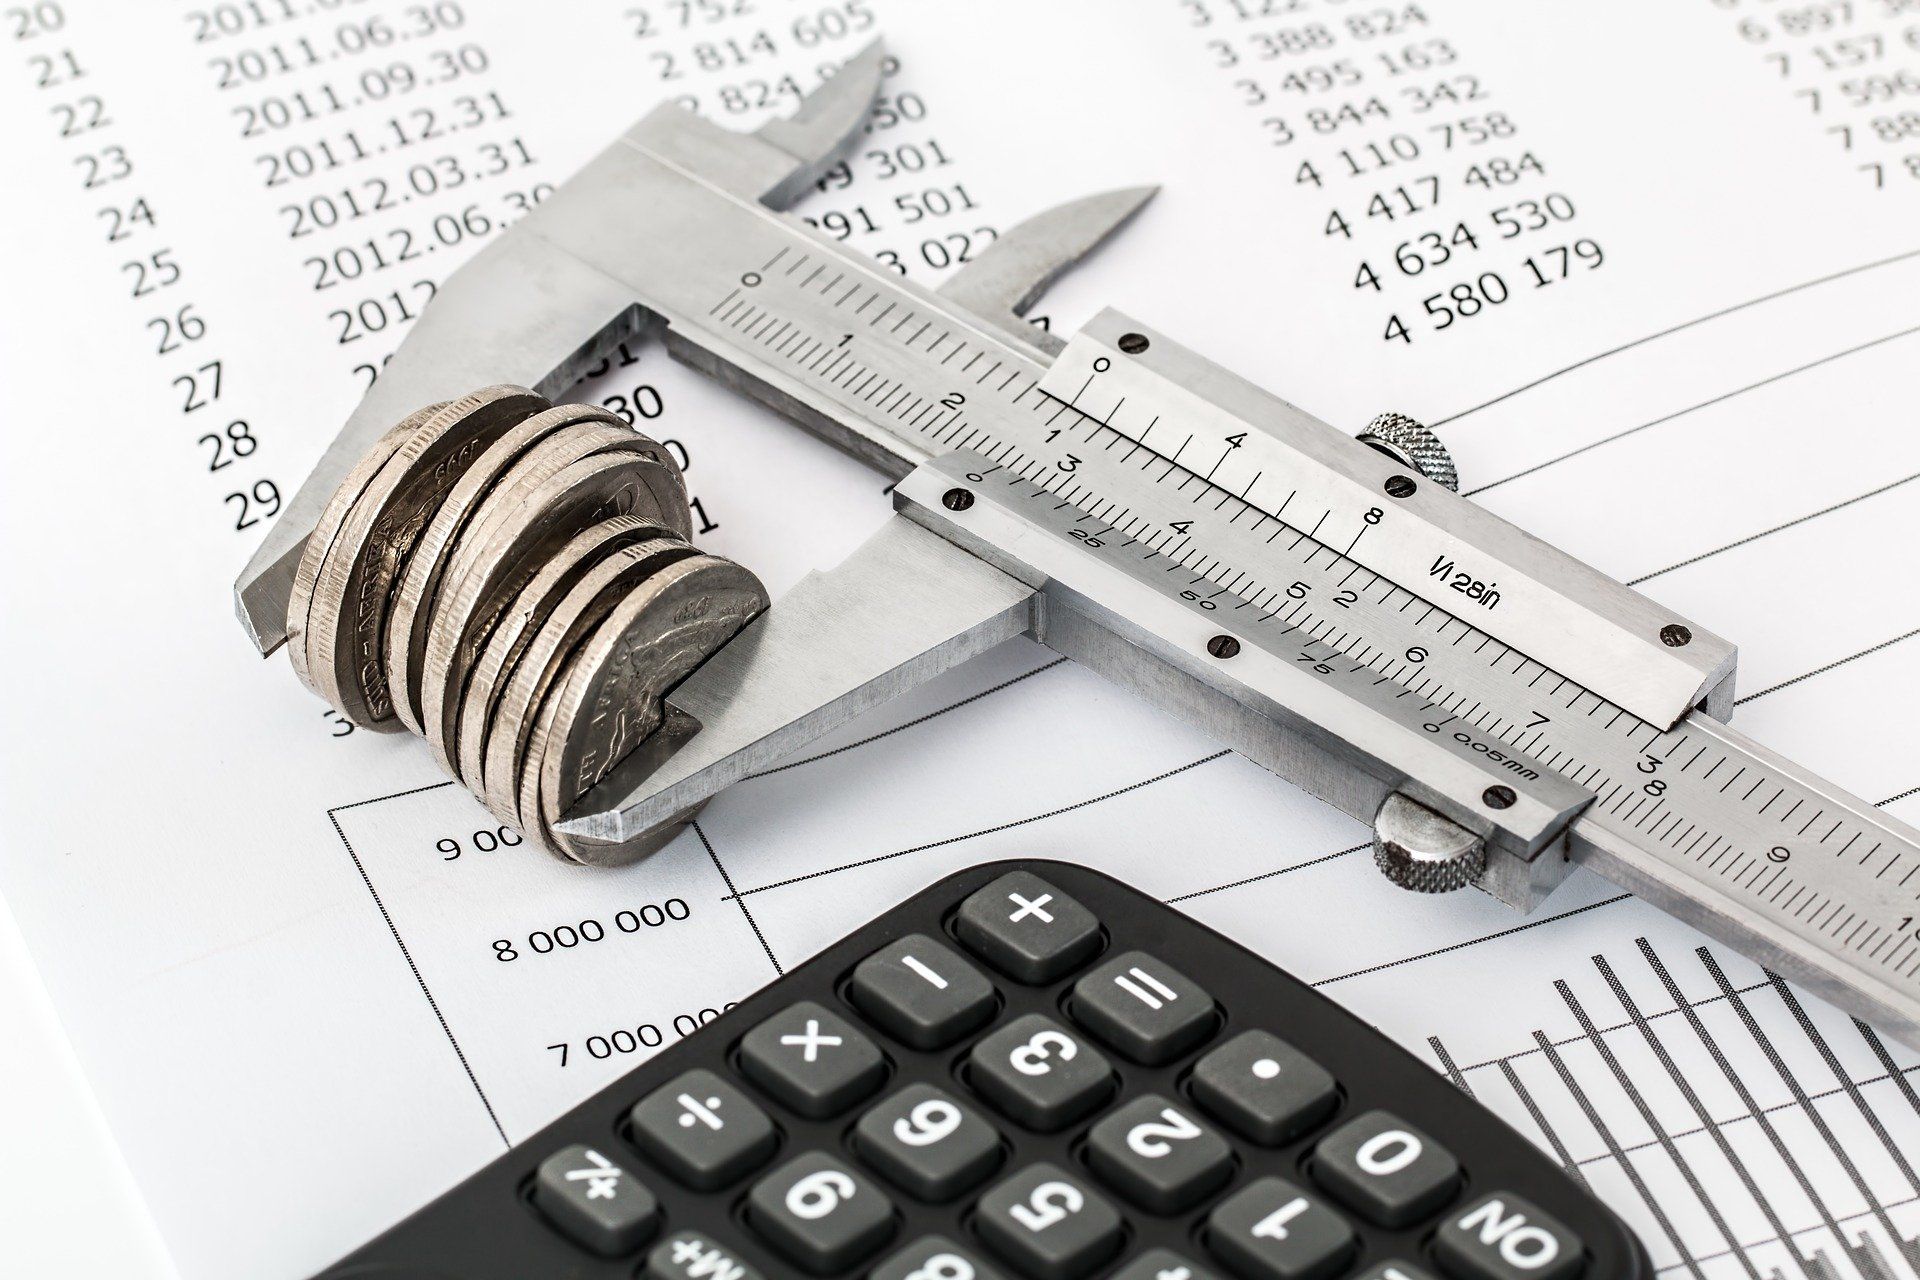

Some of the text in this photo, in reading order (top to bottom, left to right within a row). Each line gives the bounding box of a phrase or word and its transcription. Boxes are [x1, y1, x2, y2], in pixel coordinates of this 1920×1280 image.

[4, 0, 65, 40] 20
[207, 1, 466, 90] 2011.06.30
[791, 1, 874, 48] 605
[27, 48, 87, 89] 21
[232, 42, 490, 138] 2011.09.30
[50, 95, 113, 137] 22
[255, 91, 514, 187] 2011.12.31
[73, 145, 133, 189] 23
[866, 139, 951, 180] 301
[1295, 110, 1519, 188] 4 110 758
[279, 136, 538, 238] 2012.03.31
[894, 184, 979, 224] 501
[1325, 152, 1546, 239] 4 417 484
[97, 197, 157, 243] 24
[1354, 192, 1576, 291] 4 634 530
[121, 248, 181, 297] 25
[1384, 238, 1604, 344] 4 580 179
[147, 304, 206, 354] 26
[172, 361, 222, 413] 27
[197, 420, 258, 472] 28
[224, 479, 283, 531] 29
[1067, 528, 1106, 549] 25
[1179, 589, 1217, 611] 50
[1453, 731, 1540, 782] 0.05mm
[436, 838, 461, 861] 9
[492, 898, 691, 962] 8 000 000
[546, 1043, 569, 1067] 7
[585, 1023, 663, 1060] 000
[1009, 1030, 1078, 1076] 3
[1126, 1107, 1202, 1158] 2
[1355, 1130, 1423, 1176] 0
[1008, 1181, 1084, 1232] 5
[1251, 1197, 1310, 1240] 1
[1457, 1199, 1560, 1270] ON
